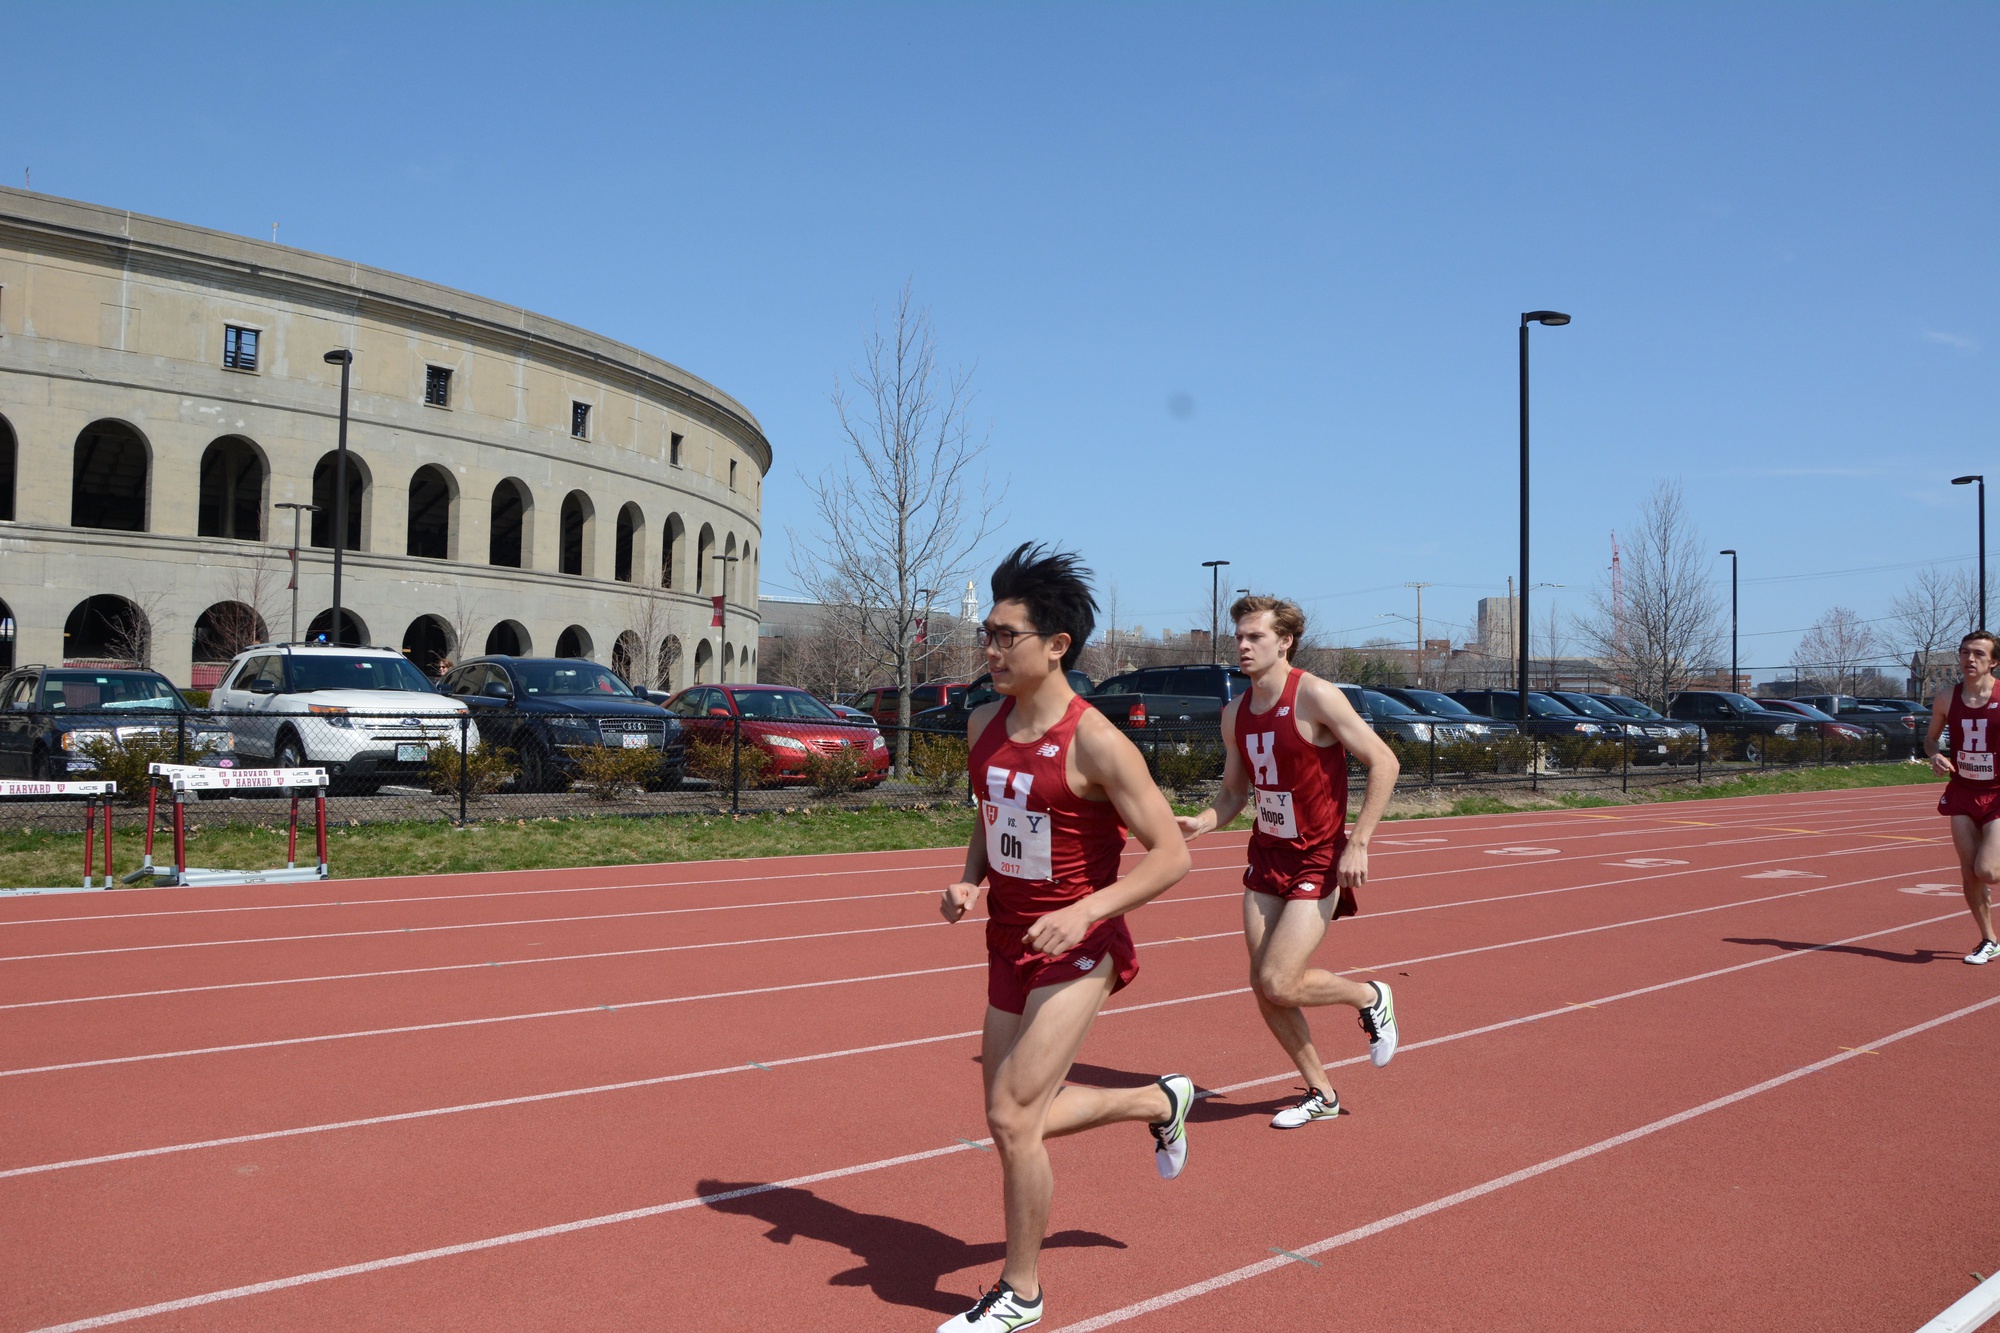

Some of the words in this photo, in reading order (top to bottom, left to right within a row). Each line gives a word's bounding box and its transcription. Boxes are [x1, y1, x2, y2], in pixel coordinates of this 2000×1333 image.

[1961, 719, 1988, 751] H
[1246, 731, 1279, 785] H
[1958, 761, 1993, 772] Williams
[9, 784, 51, 794] HARVARD
[236, 777, 272, 787] HARVARD
[1277, 794, 1287, 806] Y
[1260, 806, 1285, 826] Hope
[1026, 815, 1042, 833] Y
[1000, 833, 1022, 860] Oh
[1001, 862, 1020, 874] 2017
